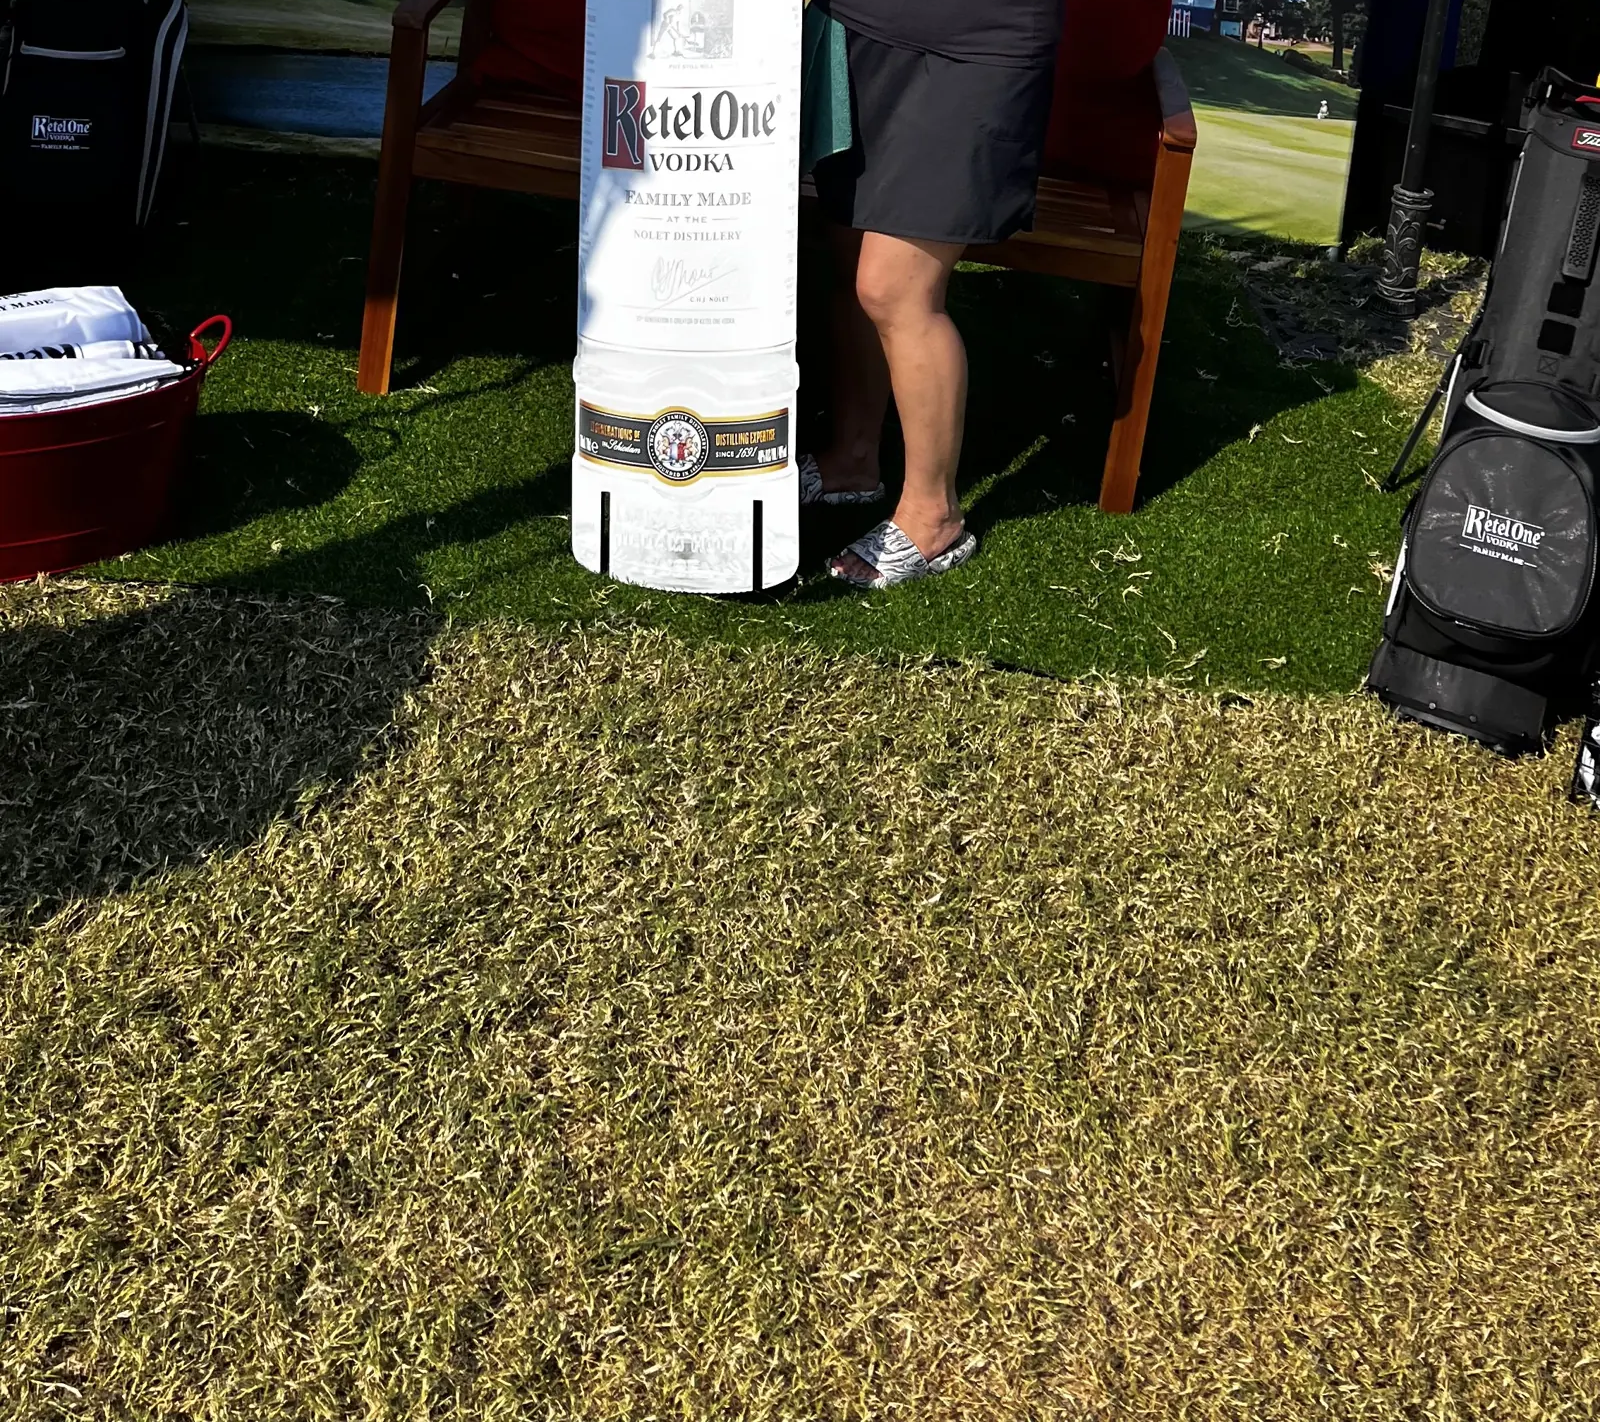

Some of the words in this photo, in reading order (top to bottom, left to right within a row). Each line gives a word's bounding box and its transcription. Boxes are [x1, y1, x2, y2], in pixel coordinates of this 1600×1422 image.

[34, 117, 67, 138] Ketel
[605, 83, 704, 165] Ketel
[649, 153, 734, 173] VODKA
[624, 189, 693, 206] FAMILY
[697, 192, 752, 207] MADE
[633, 230, 671, 241] NOLET
[673, 231, 742, 242] DISTILLERY
[10, 298, 54, 309] MADE
[715, 431, 750, 447] DISTILLING
[715, 450, 735, 458] SINCE
[735, 446, 759, 459] 1691
[1466, 508, 1511, 539] Ketel
[1486, 535, 1519, 552] VODKA
